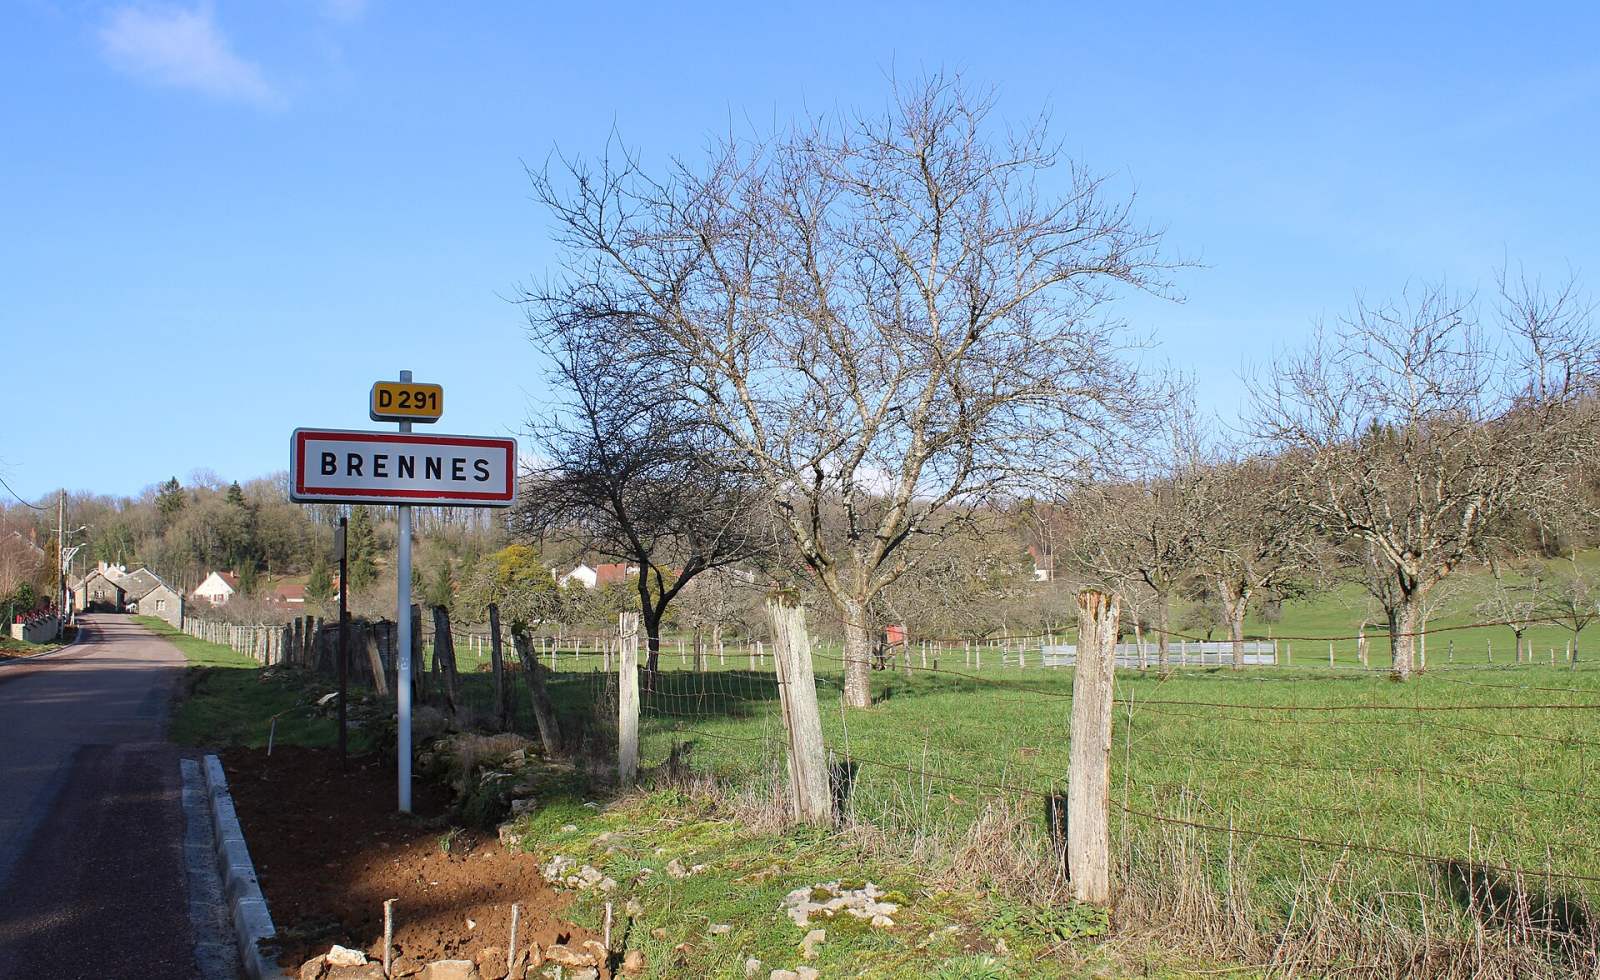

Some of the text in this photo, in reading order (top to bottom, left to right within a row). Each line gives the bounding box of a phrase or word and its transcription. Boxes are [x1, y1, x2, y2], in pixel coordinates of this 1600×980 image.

[379, 389, 437, 410] D 291
[321, 452, 490, 482] BRENNES
